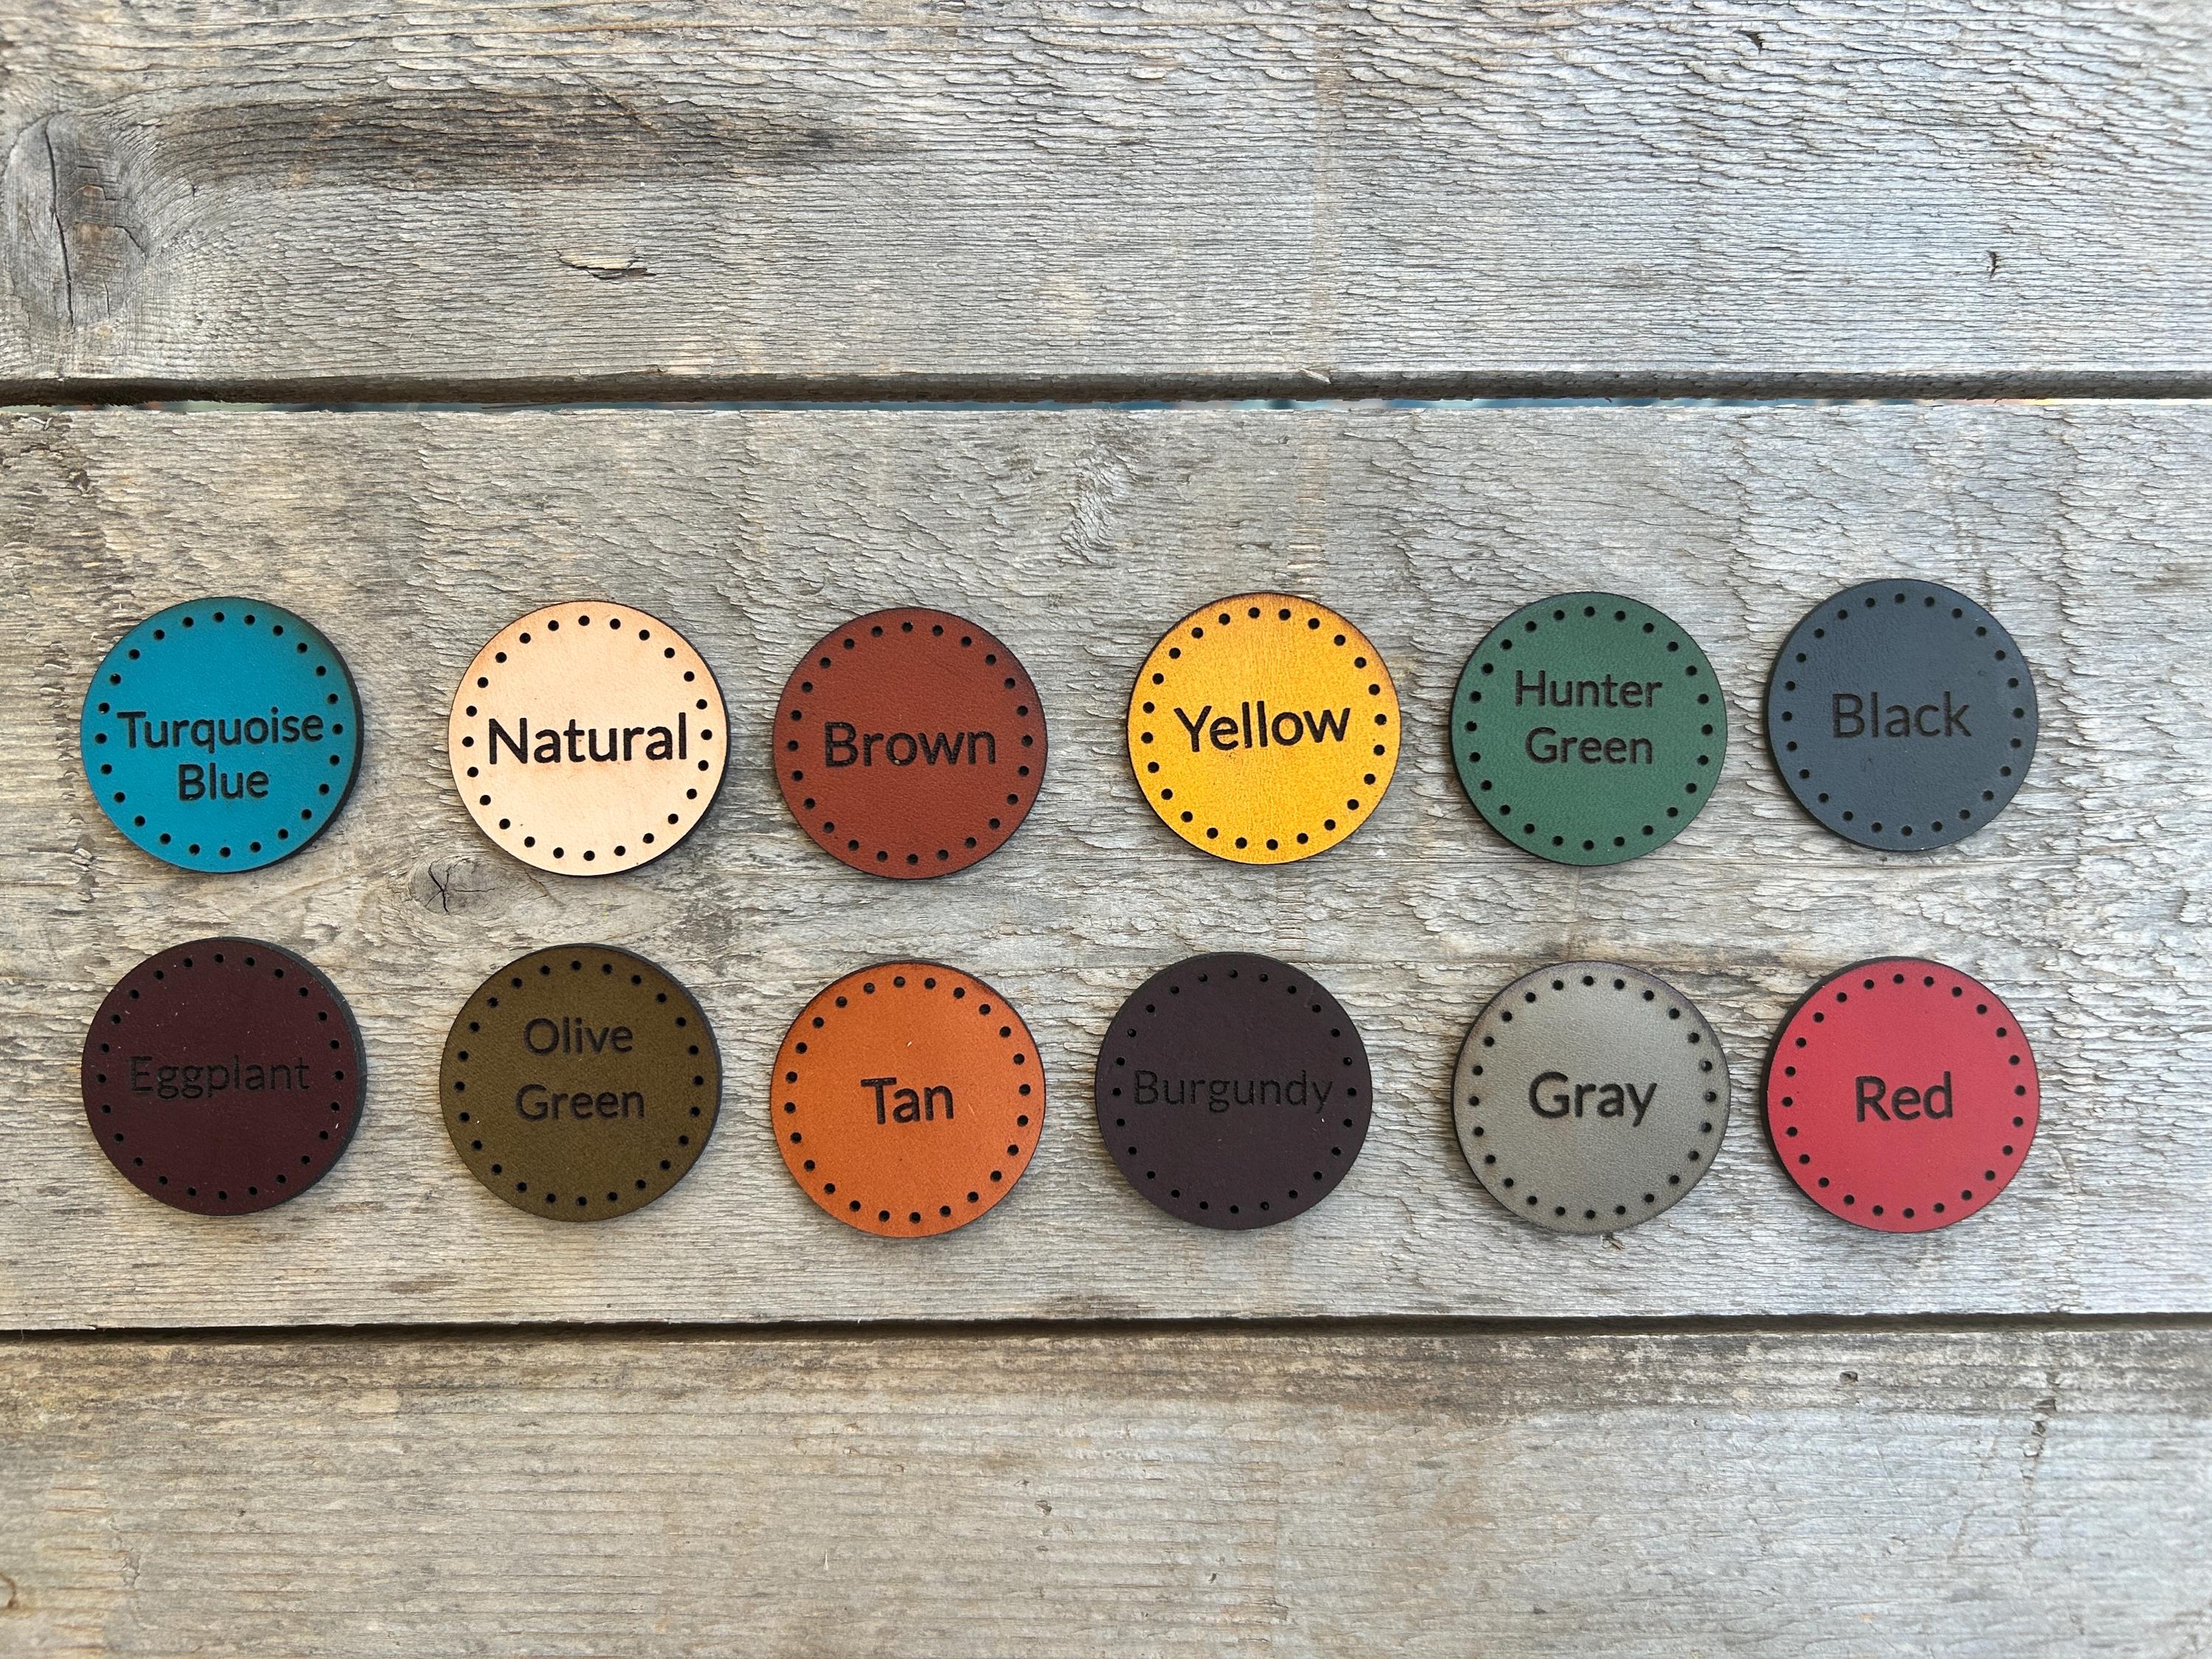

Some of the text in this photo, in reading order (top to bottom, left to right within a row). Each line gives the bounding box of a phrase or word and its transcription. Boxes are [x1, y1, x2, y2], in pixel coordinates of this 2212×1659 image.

[1515, 669, 1663, 708] Hunter
[116, 706, 324, 754] Turquoise
[1173, 700, 1351, 754] Yellow
[1832, 691, 1973, 738] Black
[488, 712, 687, 765] Natural
[824, 721, 996, 768] Brown
[1526, 726, 1653, 765] Green
[178, 762, 269, 801] Blue
[524, 1017, 633, 1056] Olive
[130, 1054, 310, 1100] Eggplant
[1134, 1069, 1333, 1114] Burgundy
[1528, 1071, 1658, 1127] Gray
[1856, 1071, 1953, 1122] Red
[516, 1084, 644, 1121] Green
[860, 1077, 954, 1125] Tan
